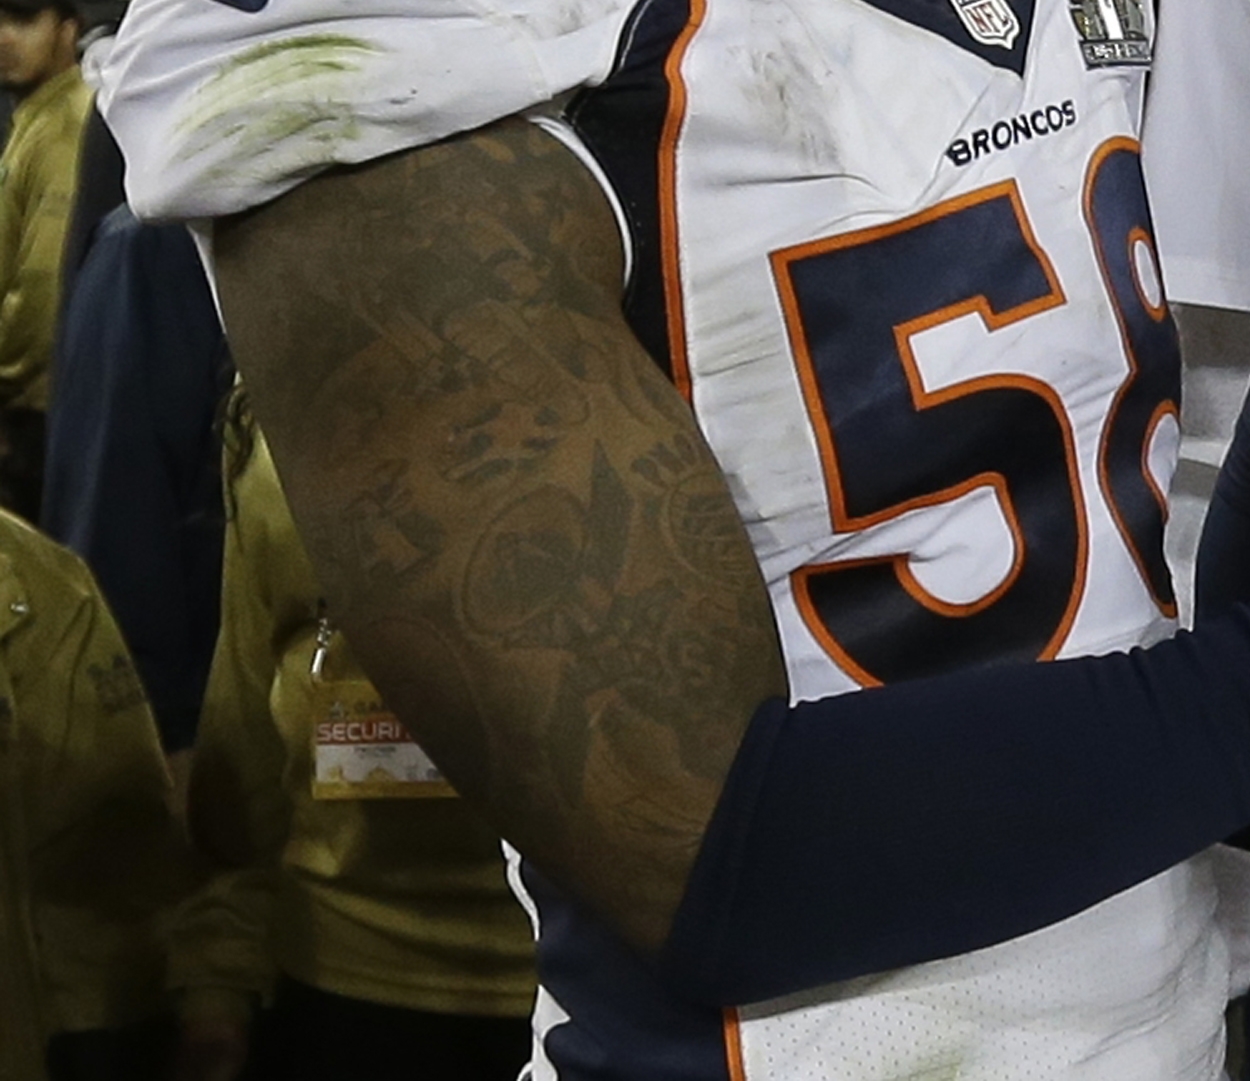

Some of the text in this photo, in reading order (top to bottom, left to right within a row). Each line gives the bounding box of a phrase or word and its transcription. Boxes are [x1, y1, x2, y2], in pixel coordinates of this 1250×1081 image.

[965, 1, 1009, 33] NFL
[944, 100, 1076, 166] BRONCOS
[317, 722, 412, 741] SECURI
